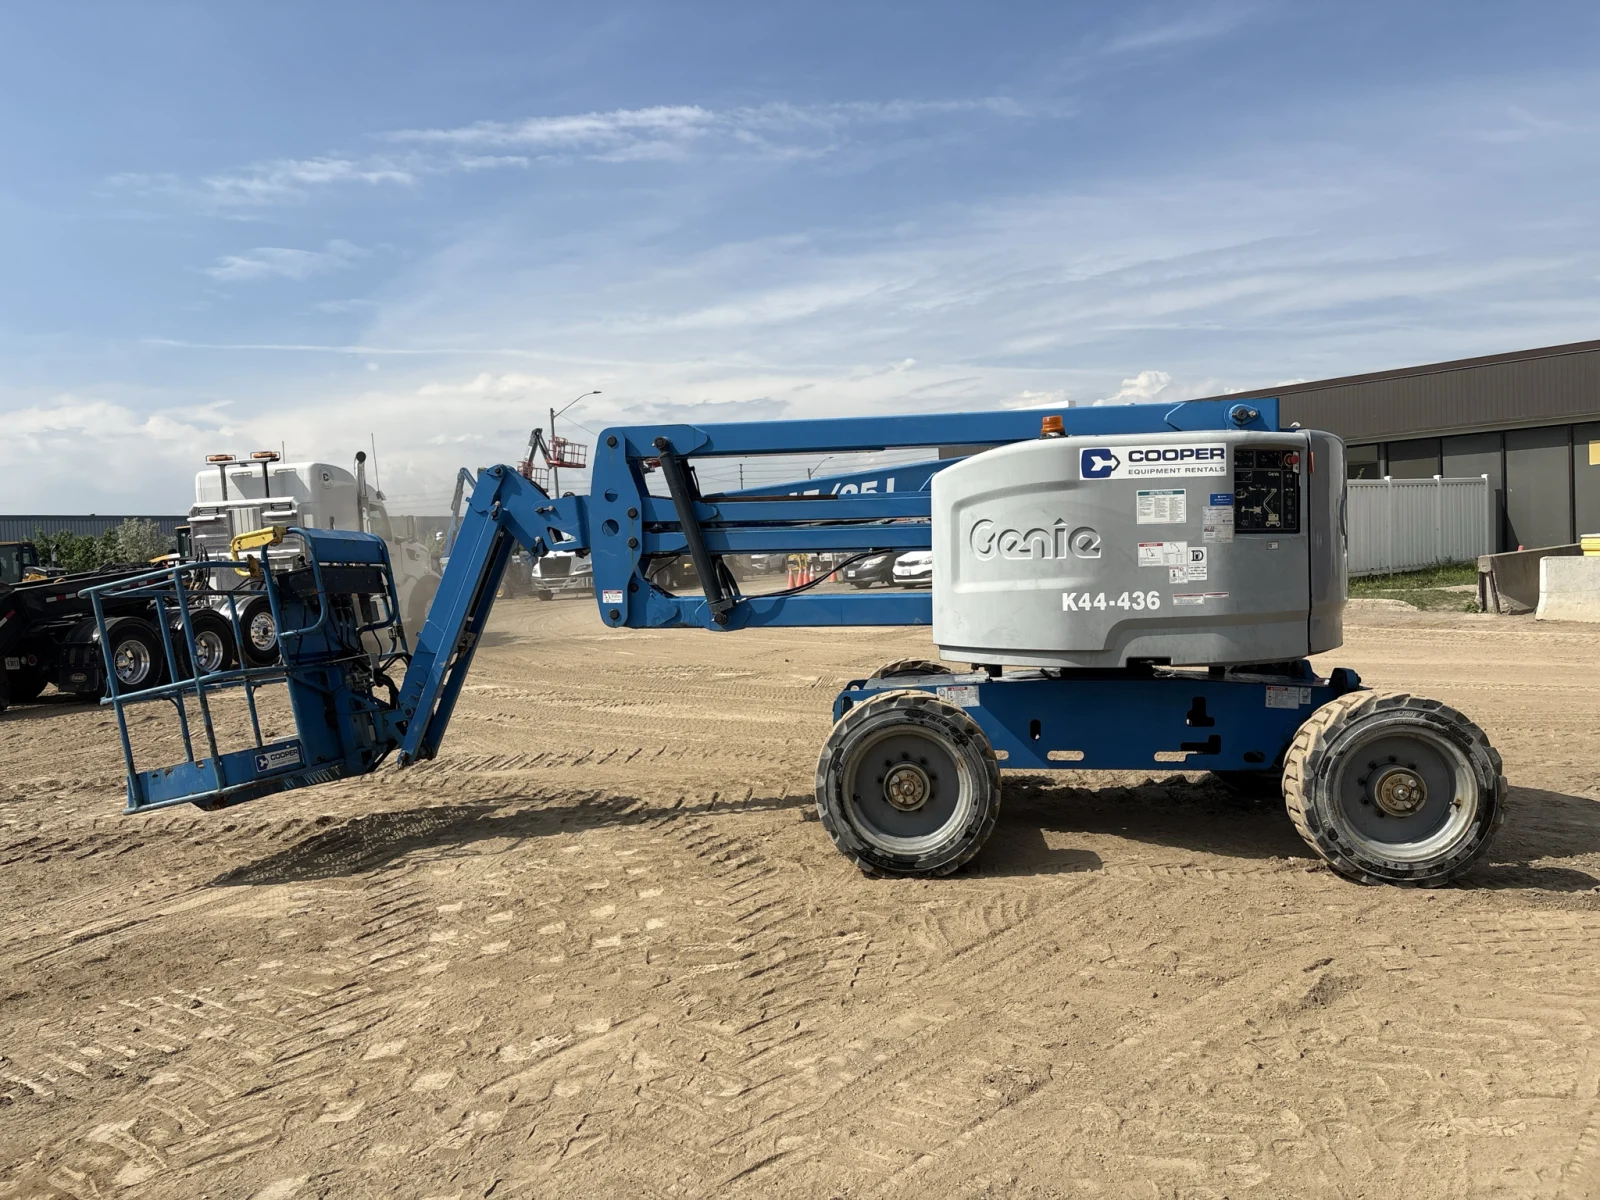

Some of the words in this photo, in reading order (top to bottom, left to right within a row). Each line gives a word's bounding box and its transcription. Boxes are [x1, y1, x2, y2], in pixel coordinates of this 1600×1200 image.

[1128, 447, 1225, 462] COOPER
[1128, 467, 1181, 475] EQUIPMENT
[970, 517, 1101, 561] Genie
[1062, 590, 1161, 611] K44-436
[271, 749, 298, 760] COOPER
